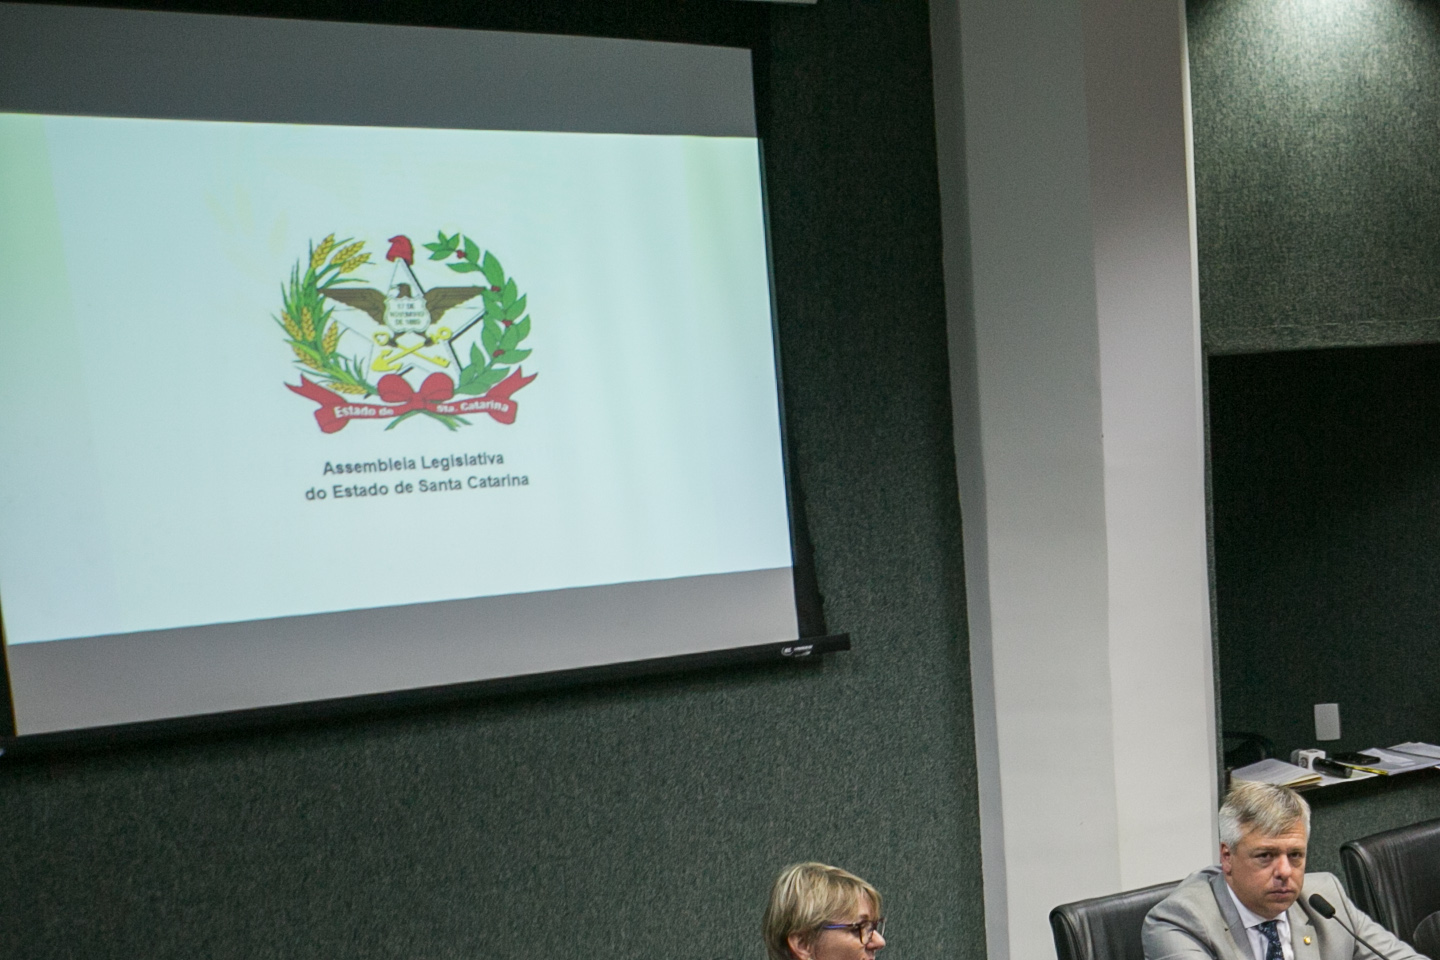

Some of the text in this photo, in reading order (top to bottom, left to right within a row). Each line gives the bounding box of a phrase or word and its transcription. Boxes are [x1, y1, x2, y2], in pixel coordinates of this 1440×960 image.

[333, 399, 510, 418] Estado de Sta. Catarina
[323, 452, 505, 476] Assembleia Legislativa
[305, 473, 530, 501] do Estado de Santa Catarina
